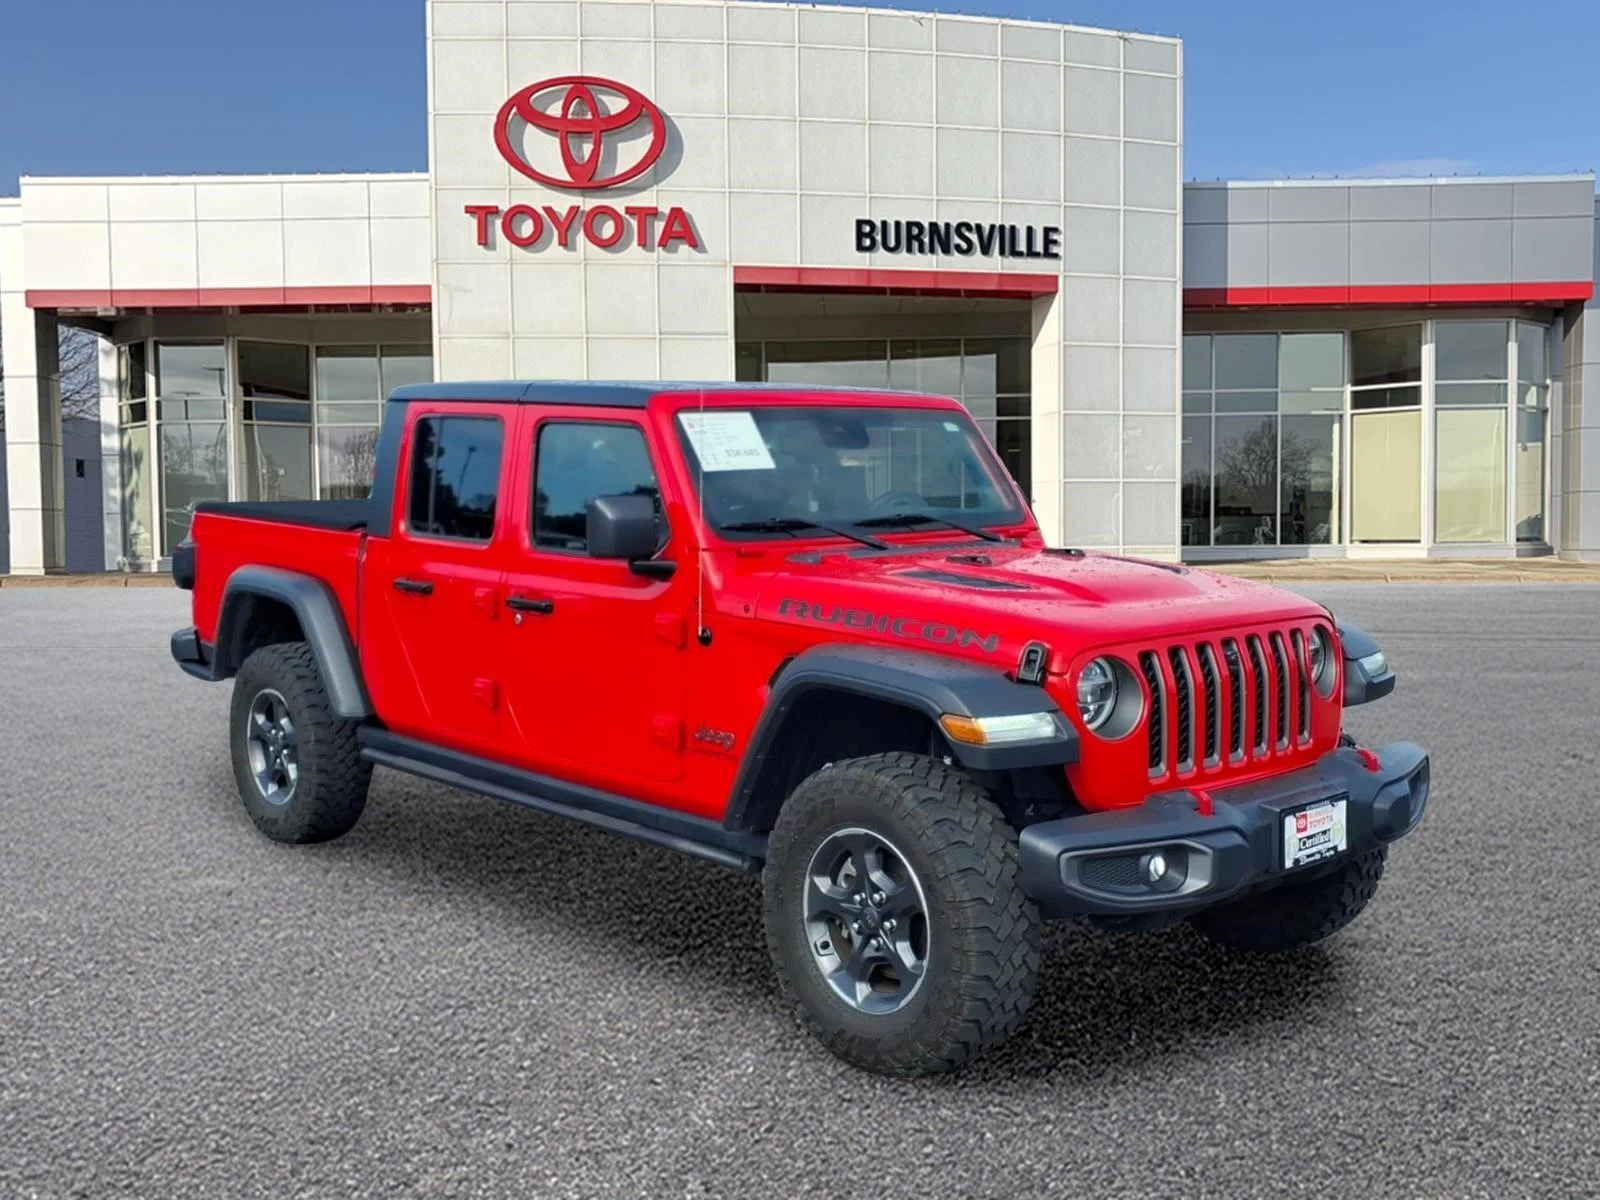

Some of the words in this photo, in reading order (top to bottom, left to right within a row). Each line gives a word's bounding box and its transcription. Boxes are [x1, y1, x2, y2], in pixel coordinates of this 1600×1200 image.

[464, 204, 699, 248] TOYOTA
[855, 219, 1061, 259] BURNSVILLE
[778, 598, 1000, 653] RUBICON
[693, 722, 735, 750] Jeep
[1309, 814, 1334, 829] TOYOTA
[1300, 830, 1330, 849] Certified
